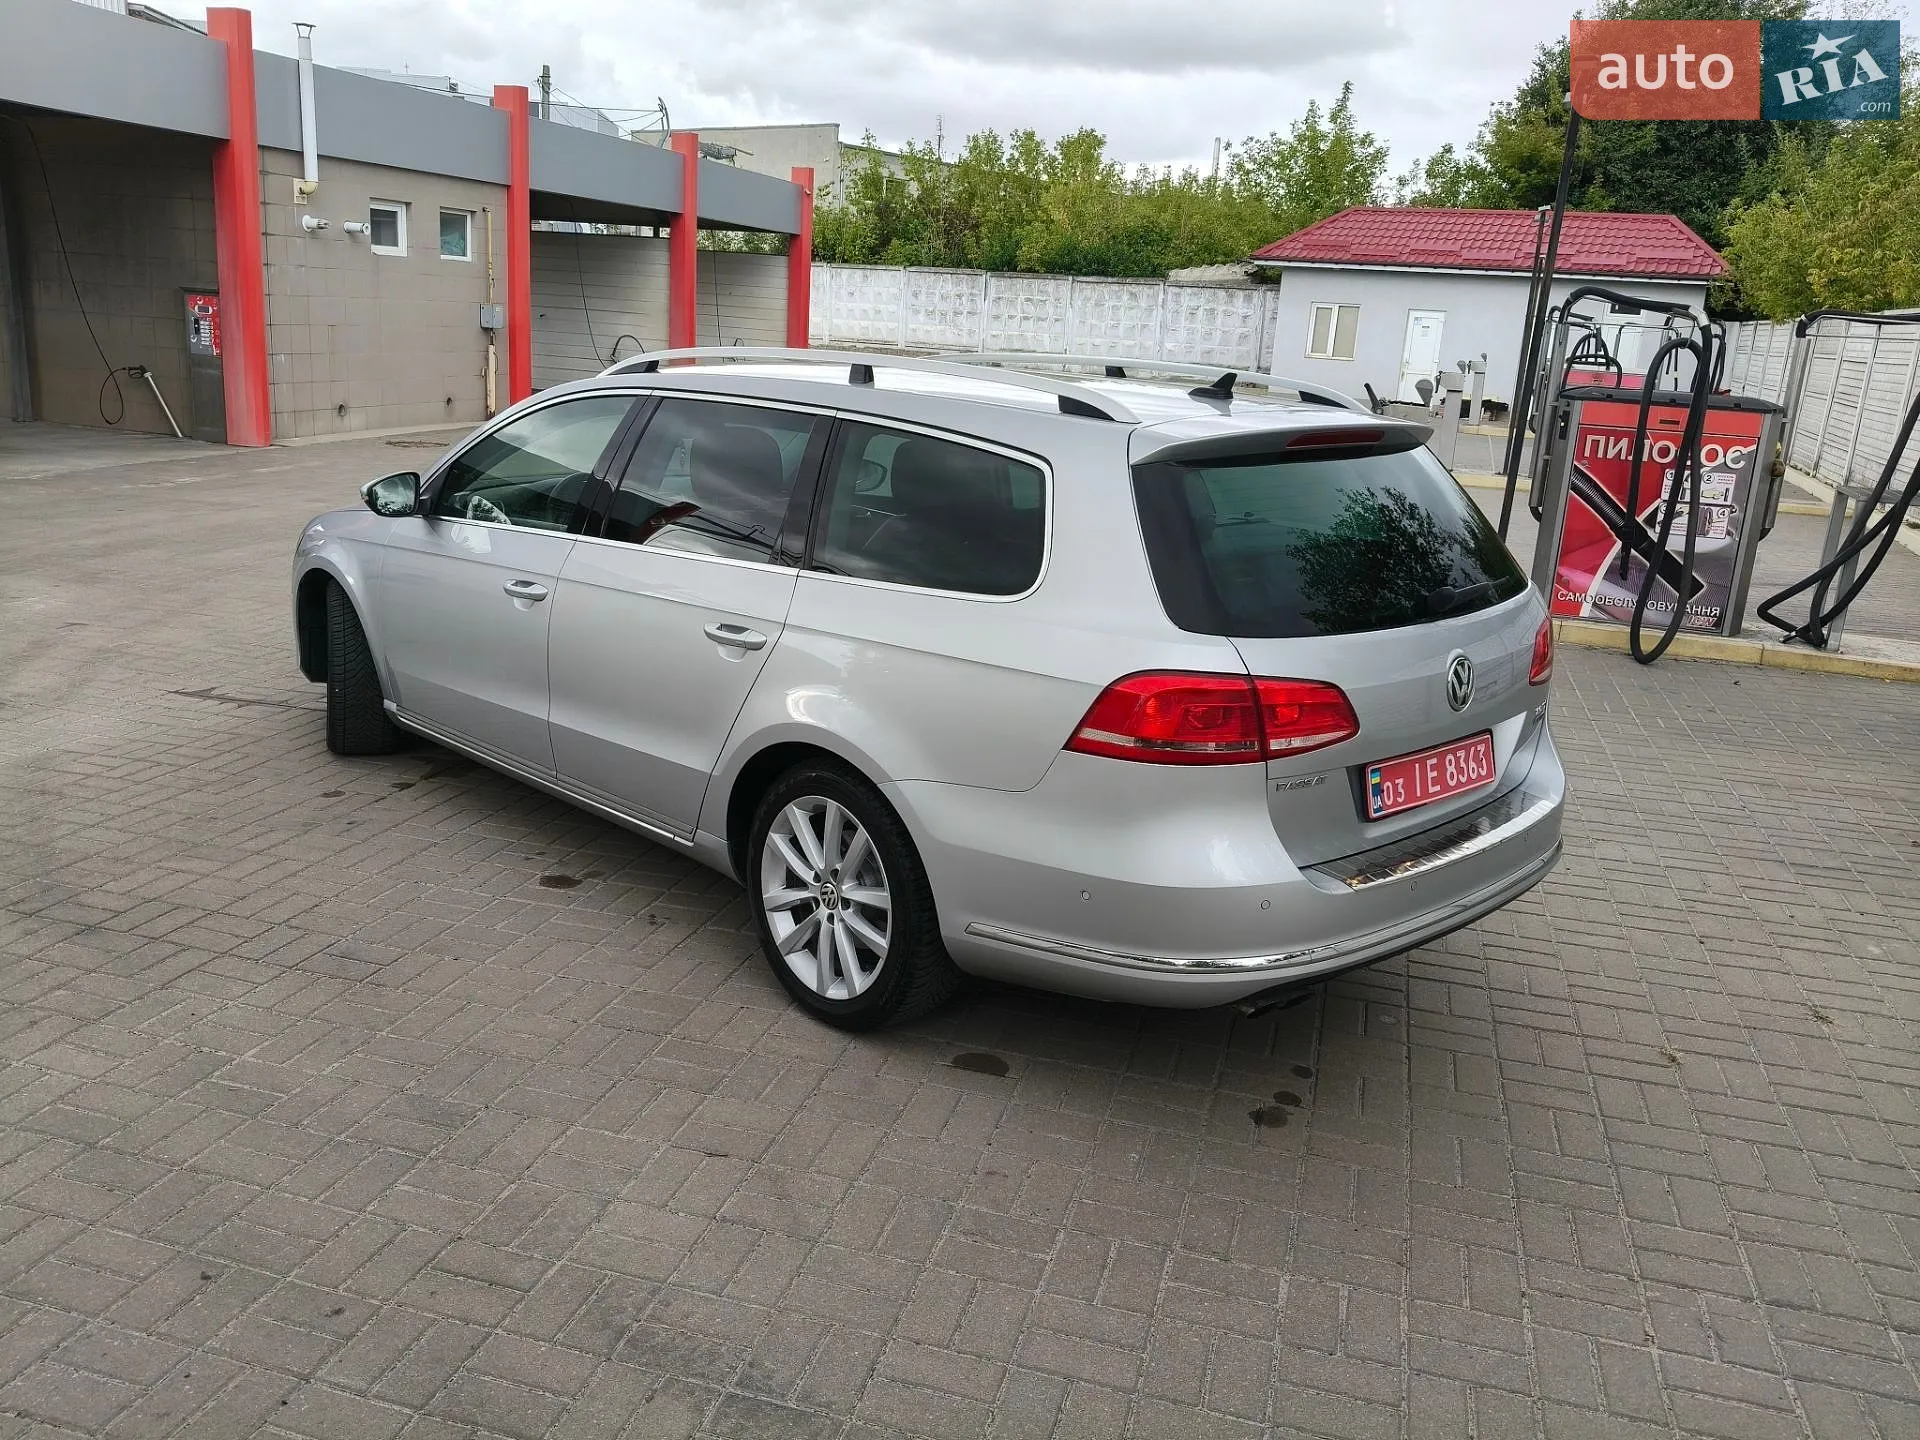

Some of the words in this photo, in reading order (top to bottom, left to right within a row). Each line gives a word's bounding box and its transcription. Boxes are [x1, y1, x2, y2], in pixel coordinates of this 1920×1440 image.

[1584, 434, 1746, 469] ПИЛООС
[1557, 590, 1721, 618] САМООБСЛУОВУАННЯ
[1383, 777, 1405, 806] 03
[1414, 757, 1441, 797] IE
[1445, 743, 1487, 787] 8363
[1372, 795, 1383, 809] UA
